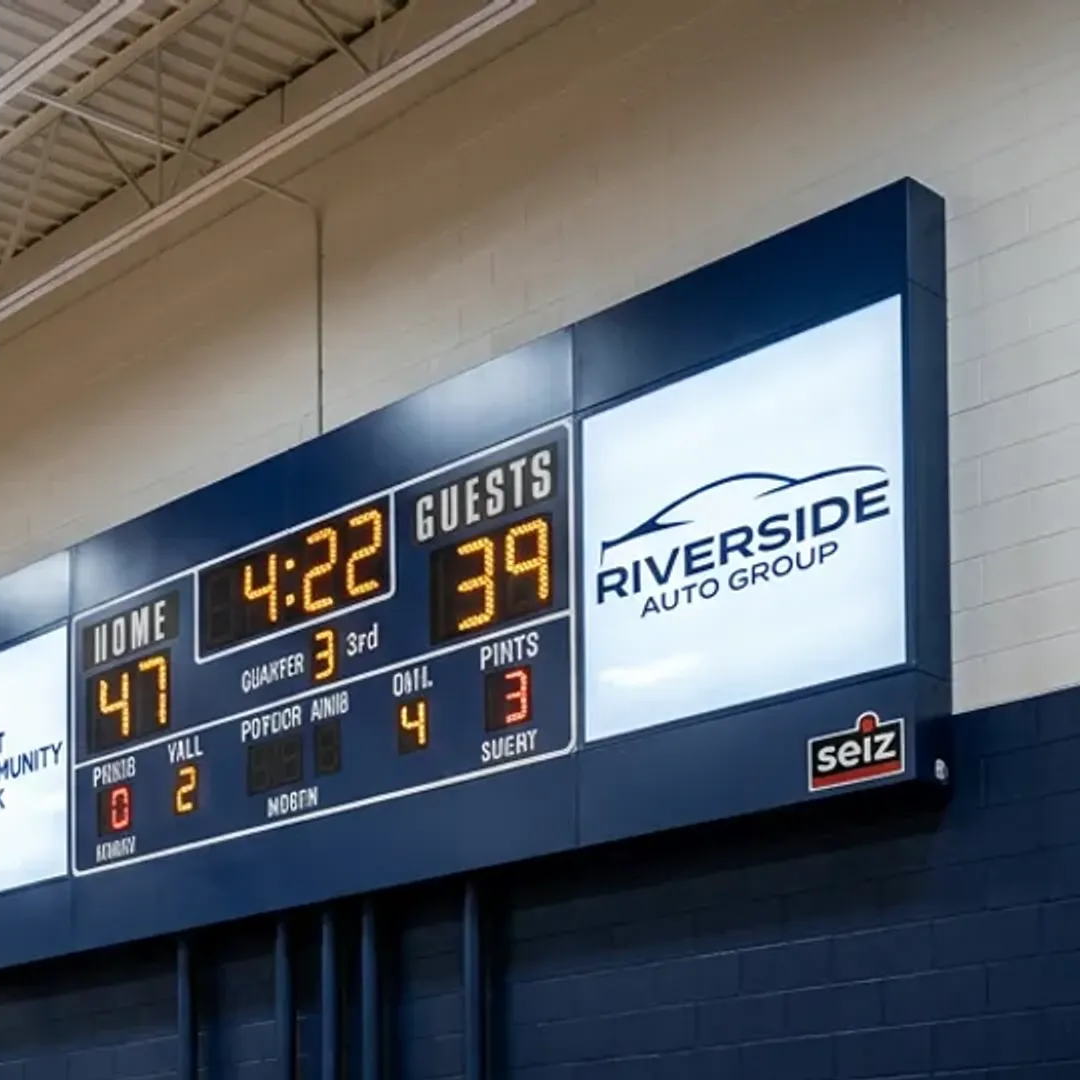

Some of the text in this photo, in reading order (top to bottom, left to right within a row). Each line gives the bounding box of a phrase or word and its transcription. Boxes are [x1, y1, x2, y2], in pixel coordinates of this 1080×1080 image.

[415, 449, 553, 543] GUESTS
[243, 508, 384, 623] 4:22
[457, 516, 549, 631] 39
[596, 479, 891, 605] RIVERSIDE
[640, 540, 839, 618] AUTO GROUP
[315, 629, 335, 680] 3
[99, 656, 168, 737] 47
[400, 701, 427, 745] 4
[505, 670, 529, 724] 3
[111, 787, 130, 829] 0
[176, 766, 197, 813] 2
